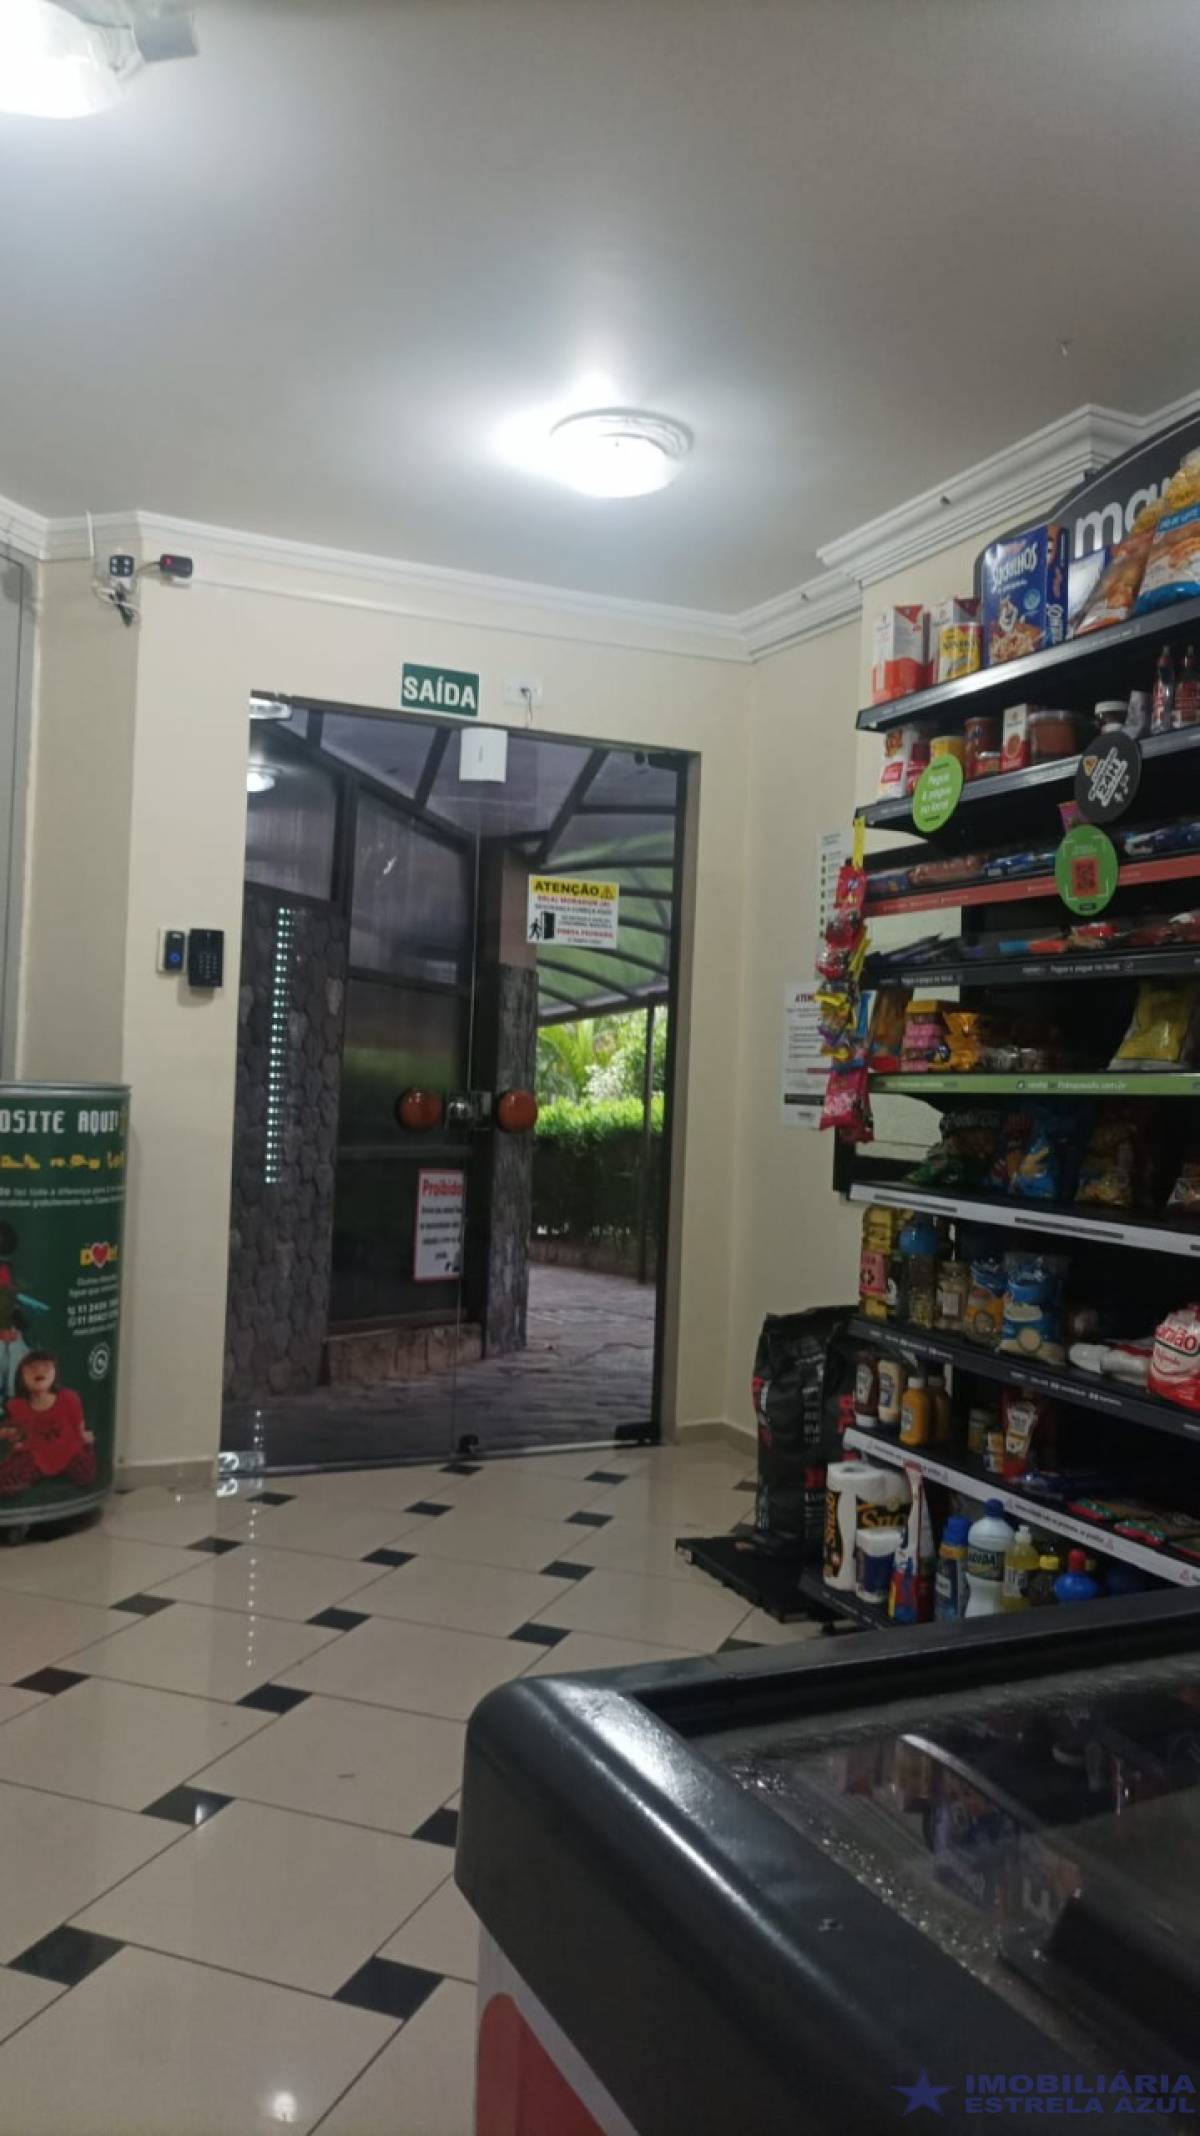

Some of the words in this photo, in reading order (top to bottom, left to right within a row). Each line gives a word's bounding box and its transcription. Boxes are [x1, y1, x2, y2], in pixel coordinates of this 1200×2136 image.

[403, 675, 476, 709] SAÍDA
[535, 880, 599, 897] ATENÇÃO
[0, 1109, 65, 1133] OSITE
